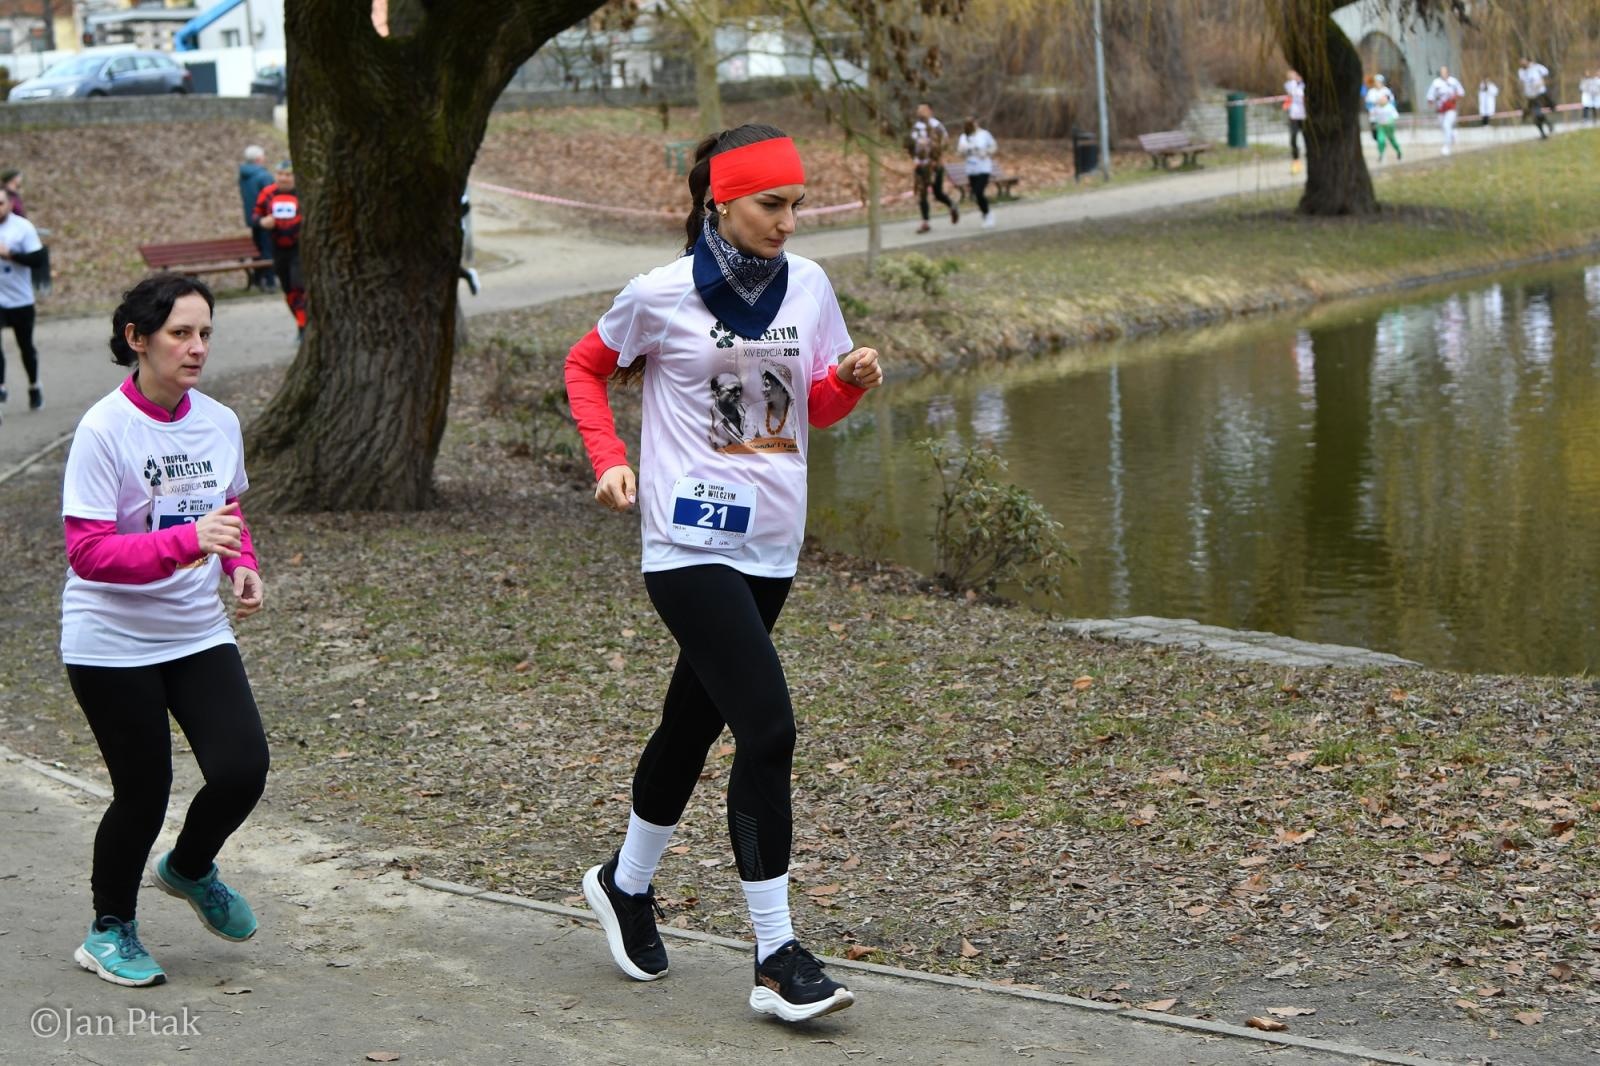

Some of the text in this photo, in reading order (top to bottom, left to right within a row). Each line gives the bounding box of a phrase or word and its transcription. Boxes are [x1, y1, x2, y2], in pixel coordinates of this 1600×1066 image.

[744, 347, 800, 357] XIV EDYCJA 2026
[162, 454, 188, 465] TROPEM
[165, 460, 213, 478] WILCZYM
[202, 480, 218, 489] 2026
[708, 490, 736, 501] WILCZYM
[190, 503, 213, 511] WILCZYM
[697, 503, 728, 529] 21
